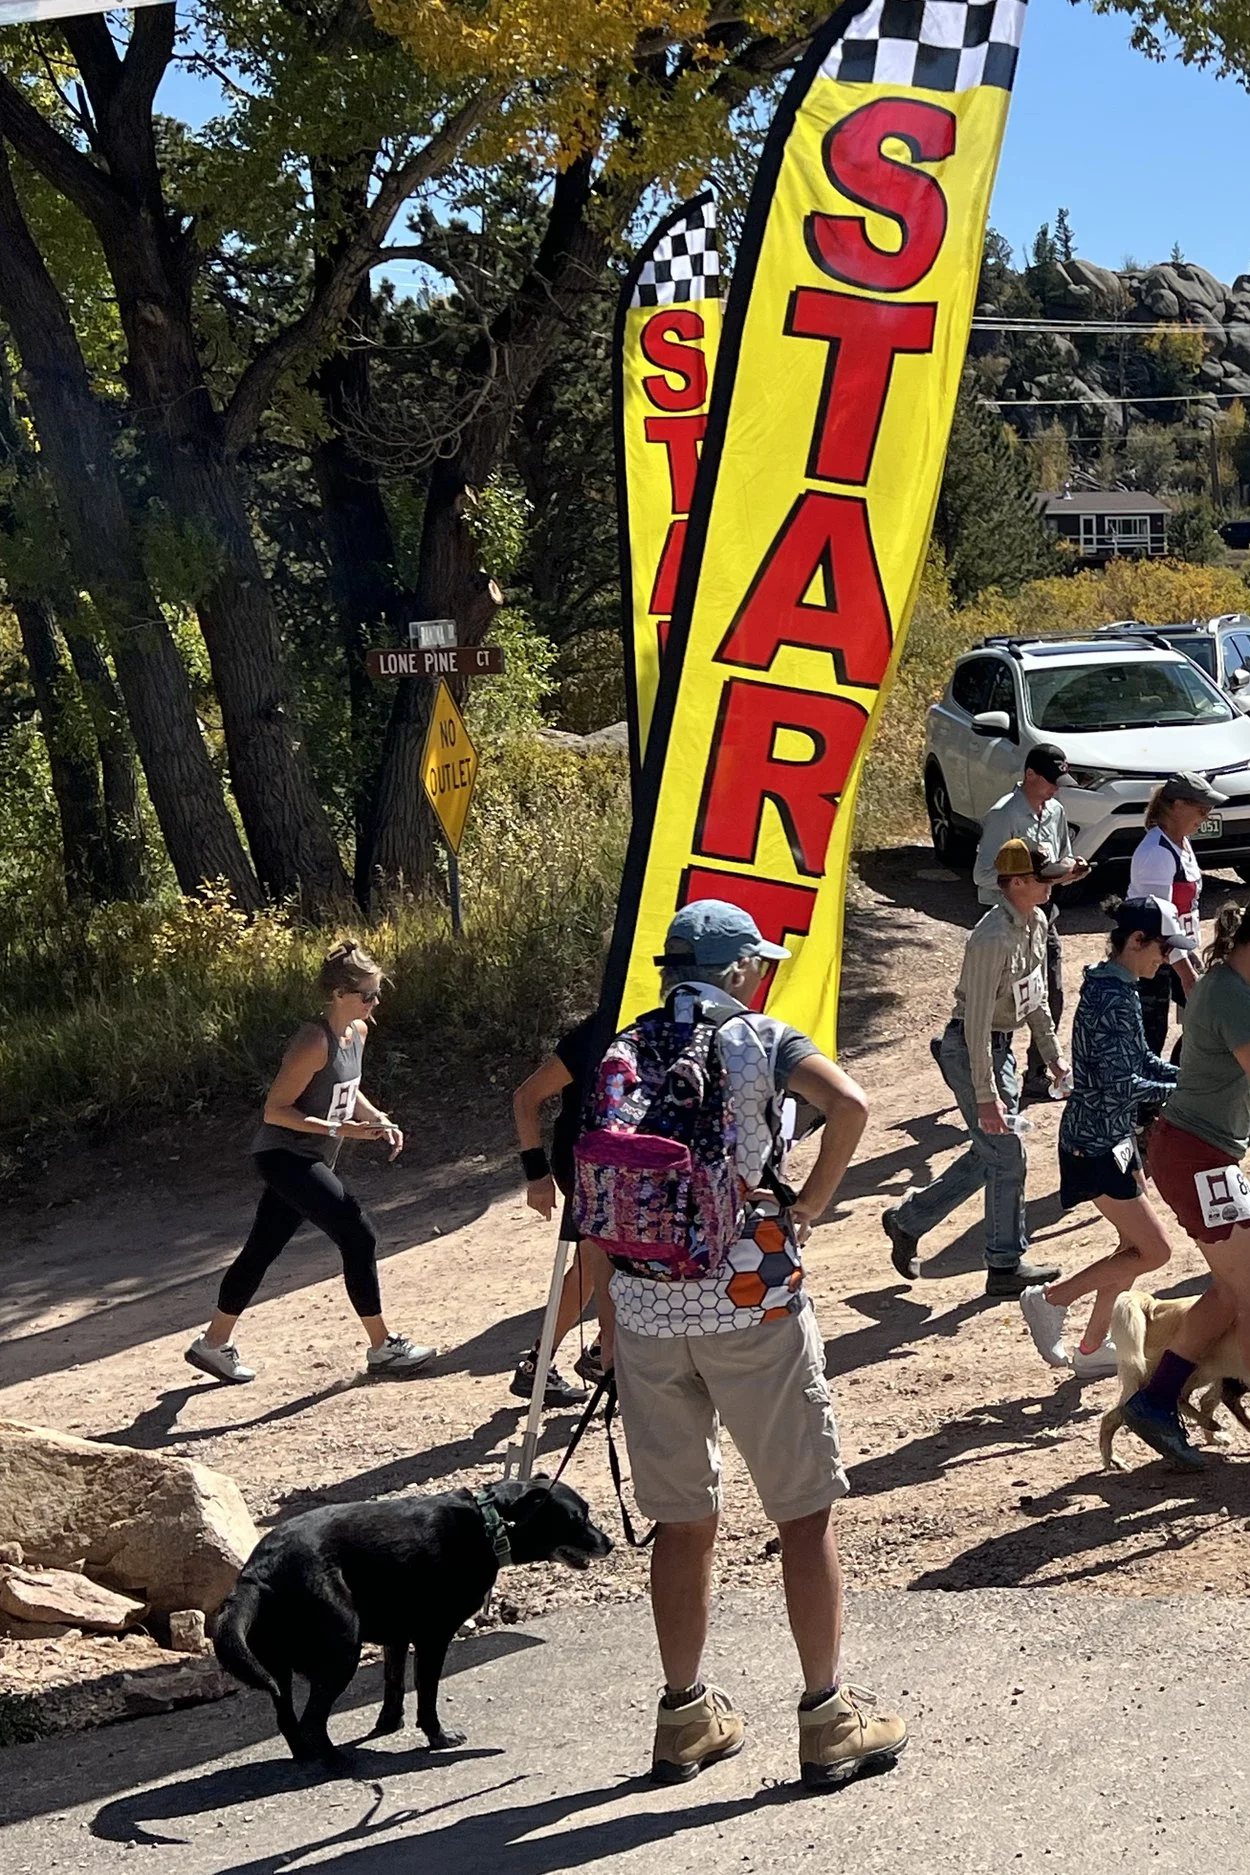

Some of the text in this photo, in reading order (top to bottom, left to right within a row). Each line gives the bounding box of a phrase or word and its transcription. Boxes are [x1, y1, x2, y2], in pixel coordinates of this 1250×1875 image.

[675, 96, 956, 1013] START
[379, 650, 490, 675] LONE PINE CT
[440, 718, 456, 749] NO
[430, 758, 471, 796] OUTLET
